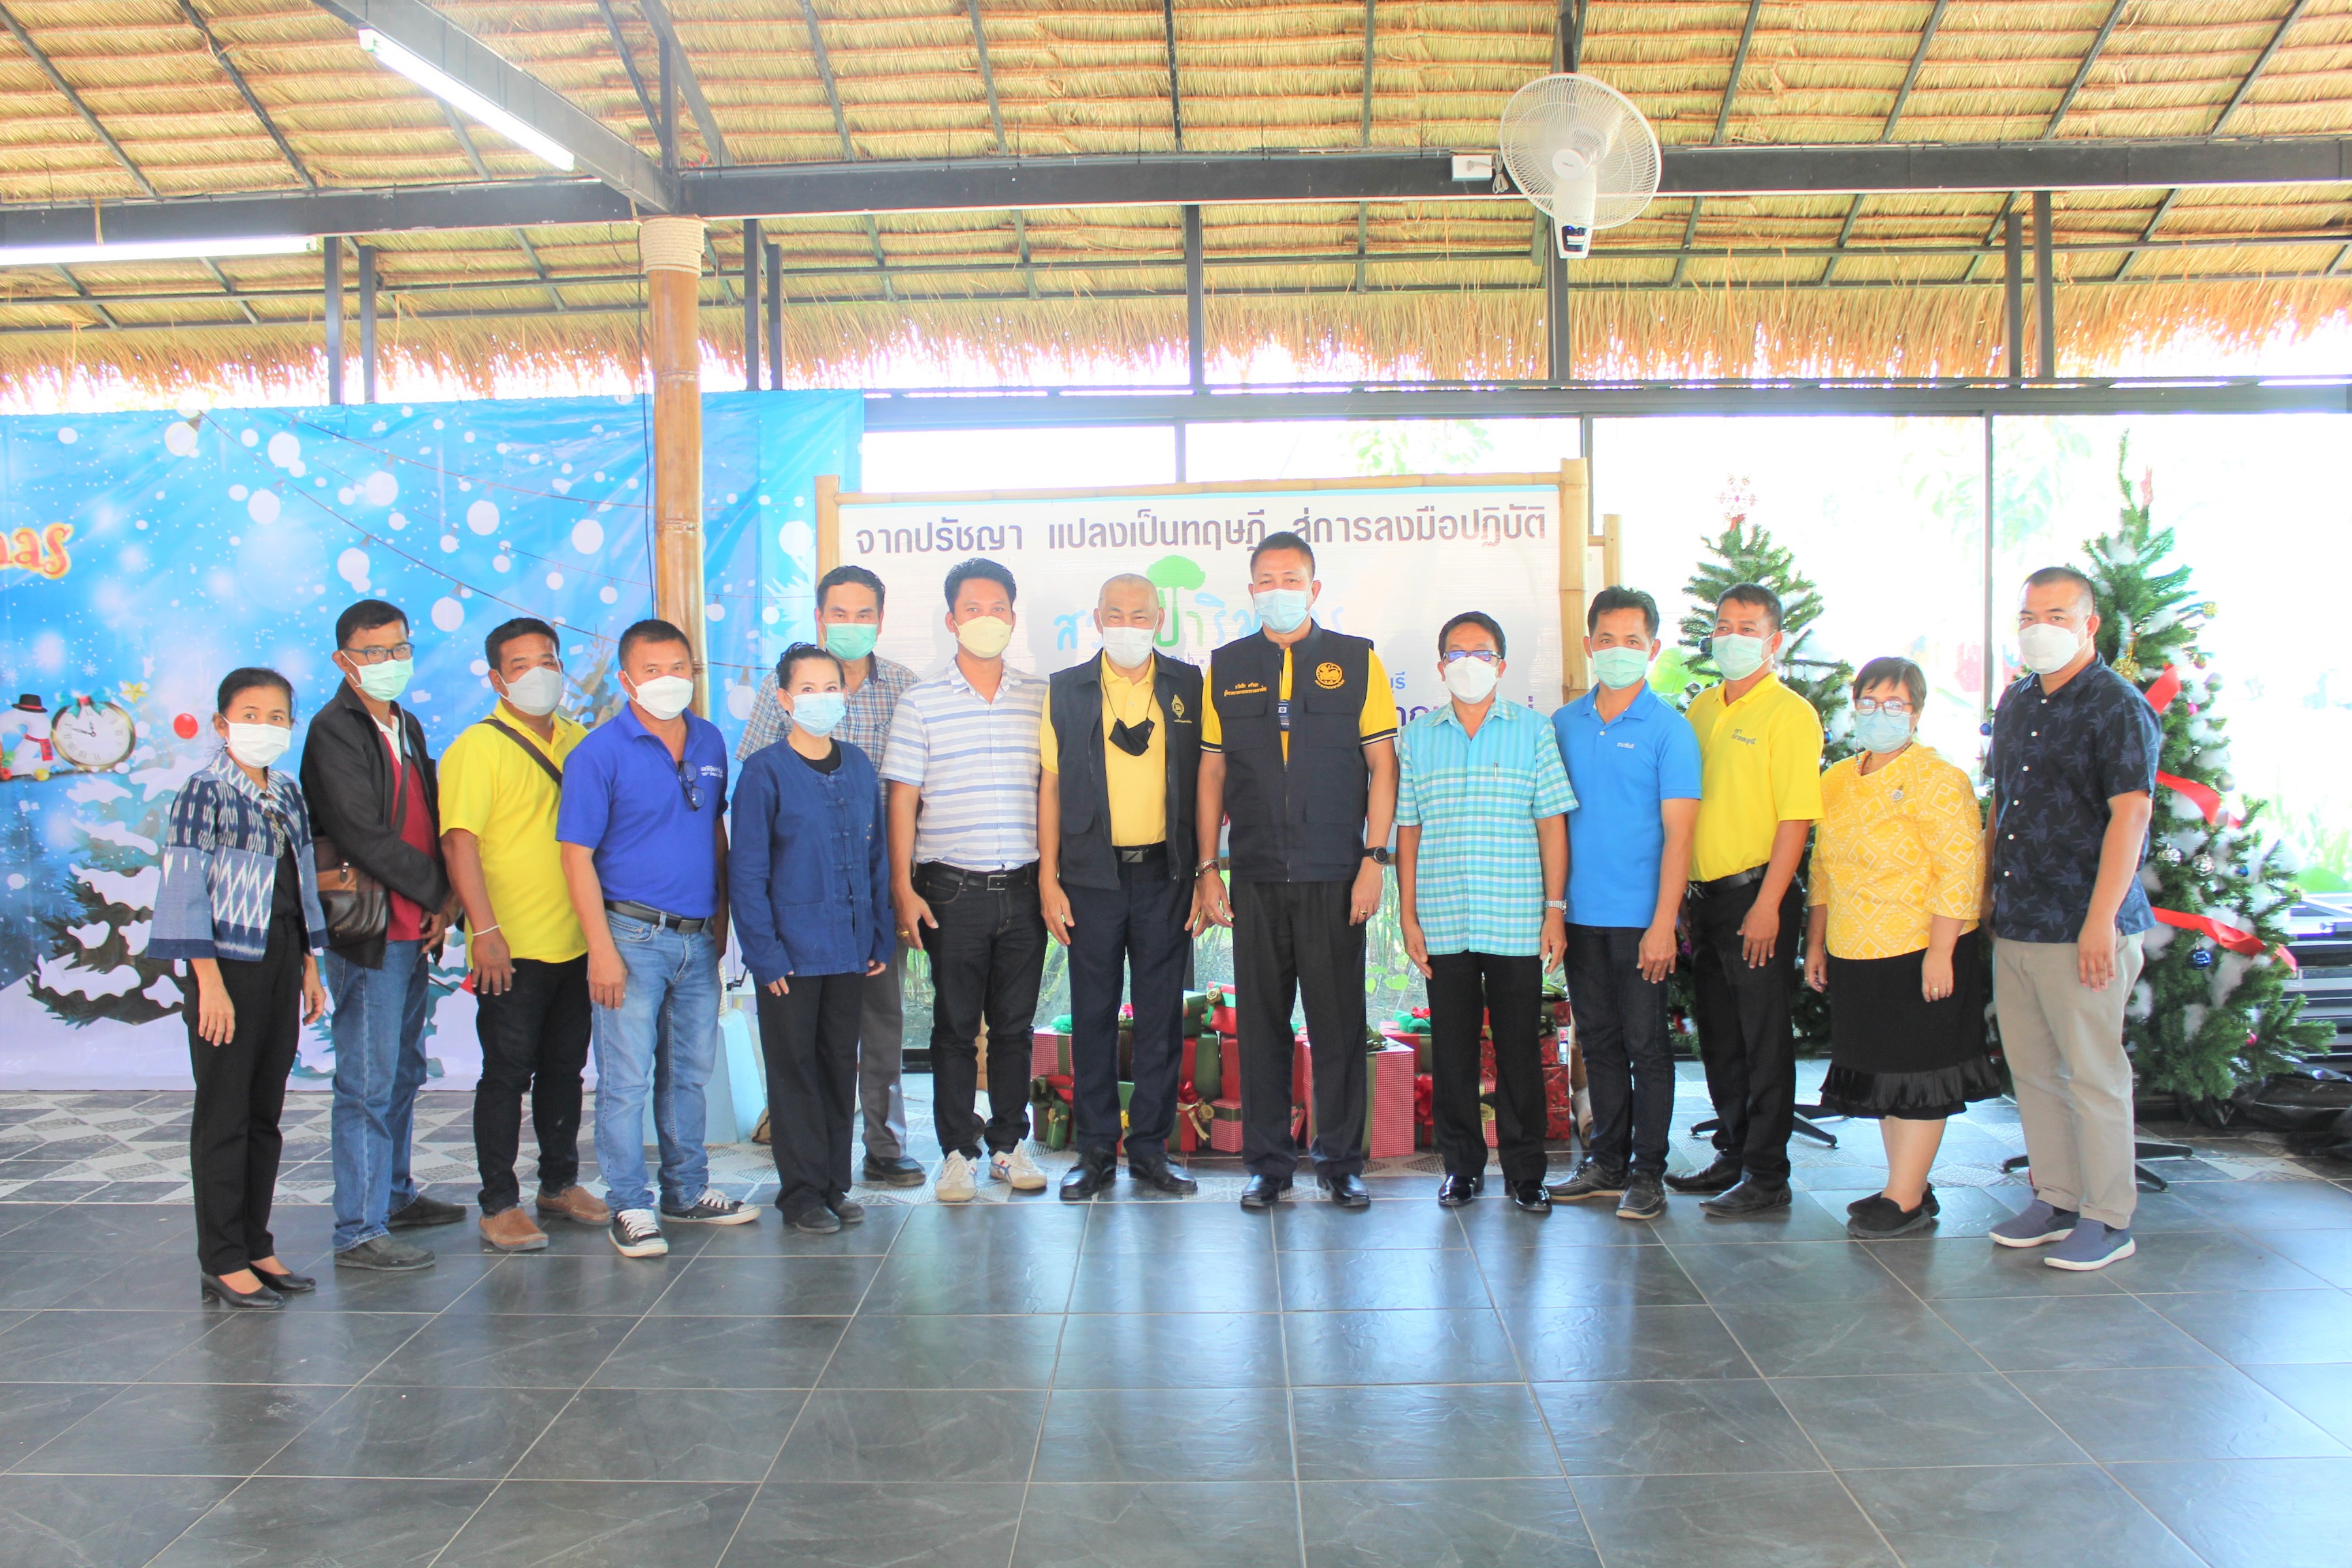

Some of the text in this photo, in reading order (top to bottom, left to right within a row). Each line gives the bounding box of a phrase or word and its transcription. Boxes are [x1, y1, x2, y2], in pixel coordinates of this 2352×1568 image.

[855, 517, 1023, 555] จากปรัชญา
[1292, 504, 1546, 548] ส่การลงมือปฏิบัติ
